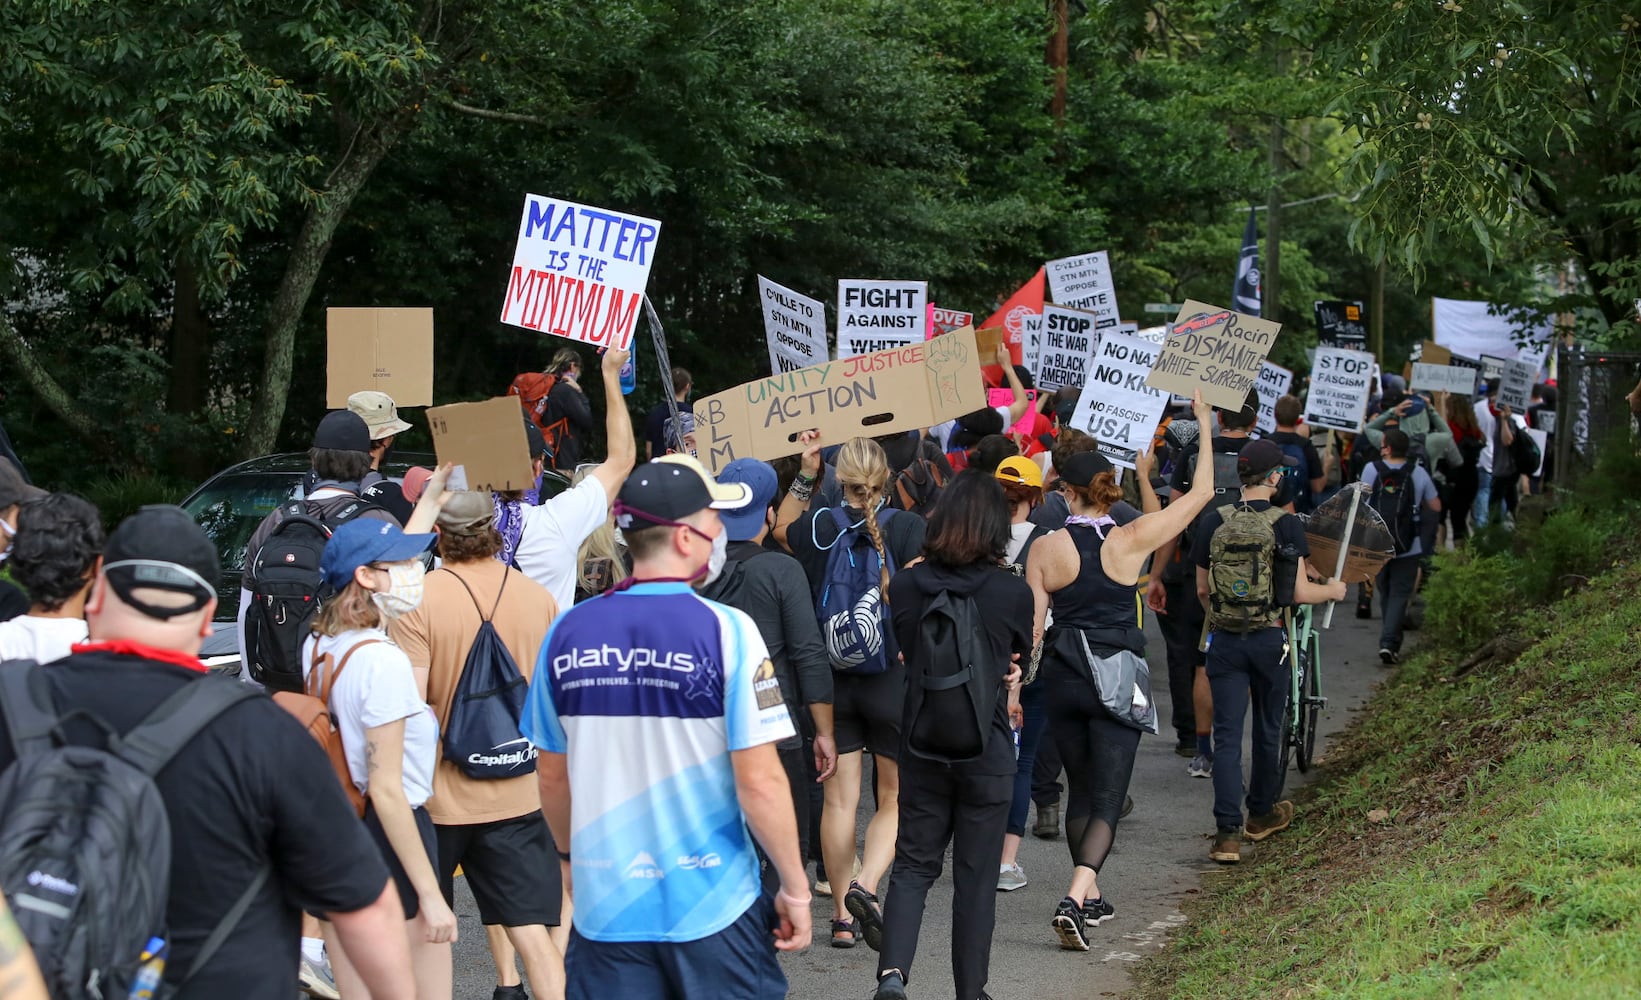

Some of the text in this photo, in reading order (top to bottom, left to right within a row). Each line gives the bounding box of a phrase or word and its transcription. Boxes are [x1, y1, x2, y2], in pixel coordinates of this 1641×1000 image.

[525, 200, 656, 265] MATTER
[546, 250, 608, 282] IS THE
[1086, 257, 1098, 265] TO
[1060, 269, 1098, 282] STN MTN
[1064, 280, 1098, 293] OPPOSE
[503, 266, 640, 349] MINIMUM
[845, 287, 918, 309] FIGHT
[799, 302, 813, 318] TO
[933, 311, 965, 326] OVE
[771, 309, 812, 338] STN MTN
[846, 315, 917, 329] AGAINST
[1048, 313, 1090, 334] STOP
[776, 331, 813, 357] OPPOSE
[1047, 332, 1064, 348] THE
[1065, 334, 1088, 352] WAR
[1103, 342, 1128, 360] NO
[1166, 334, 1265, 371] to DISMANTLE
[1044, 353, 1086, 372] ON BLACK
[1154, 351, 1200, 376] WHITE
[1320, 355, 1369, 374] STOP
[747, 346, 925, 403] UNITY JUSTICE
[1040, 366, 1086, 388] AMERICA!
[1094, 364, 1123, 385] NO
[1258, 366, 1288, 388] IGHT
[1317, 373, 1365, 388] FASCISM
[1255, 382, 1281, 400] GAINST
[764, 376, 877, 428] ACTION
[1089, 400, 1149, 424] NO FASCIST
[1316, 398, 1356, 410] WILL STOP
[1333, 410, 1347, 418] ALL
[1086, 413, 1131, 443] USA
[553, 643, 696, 680] platypus
